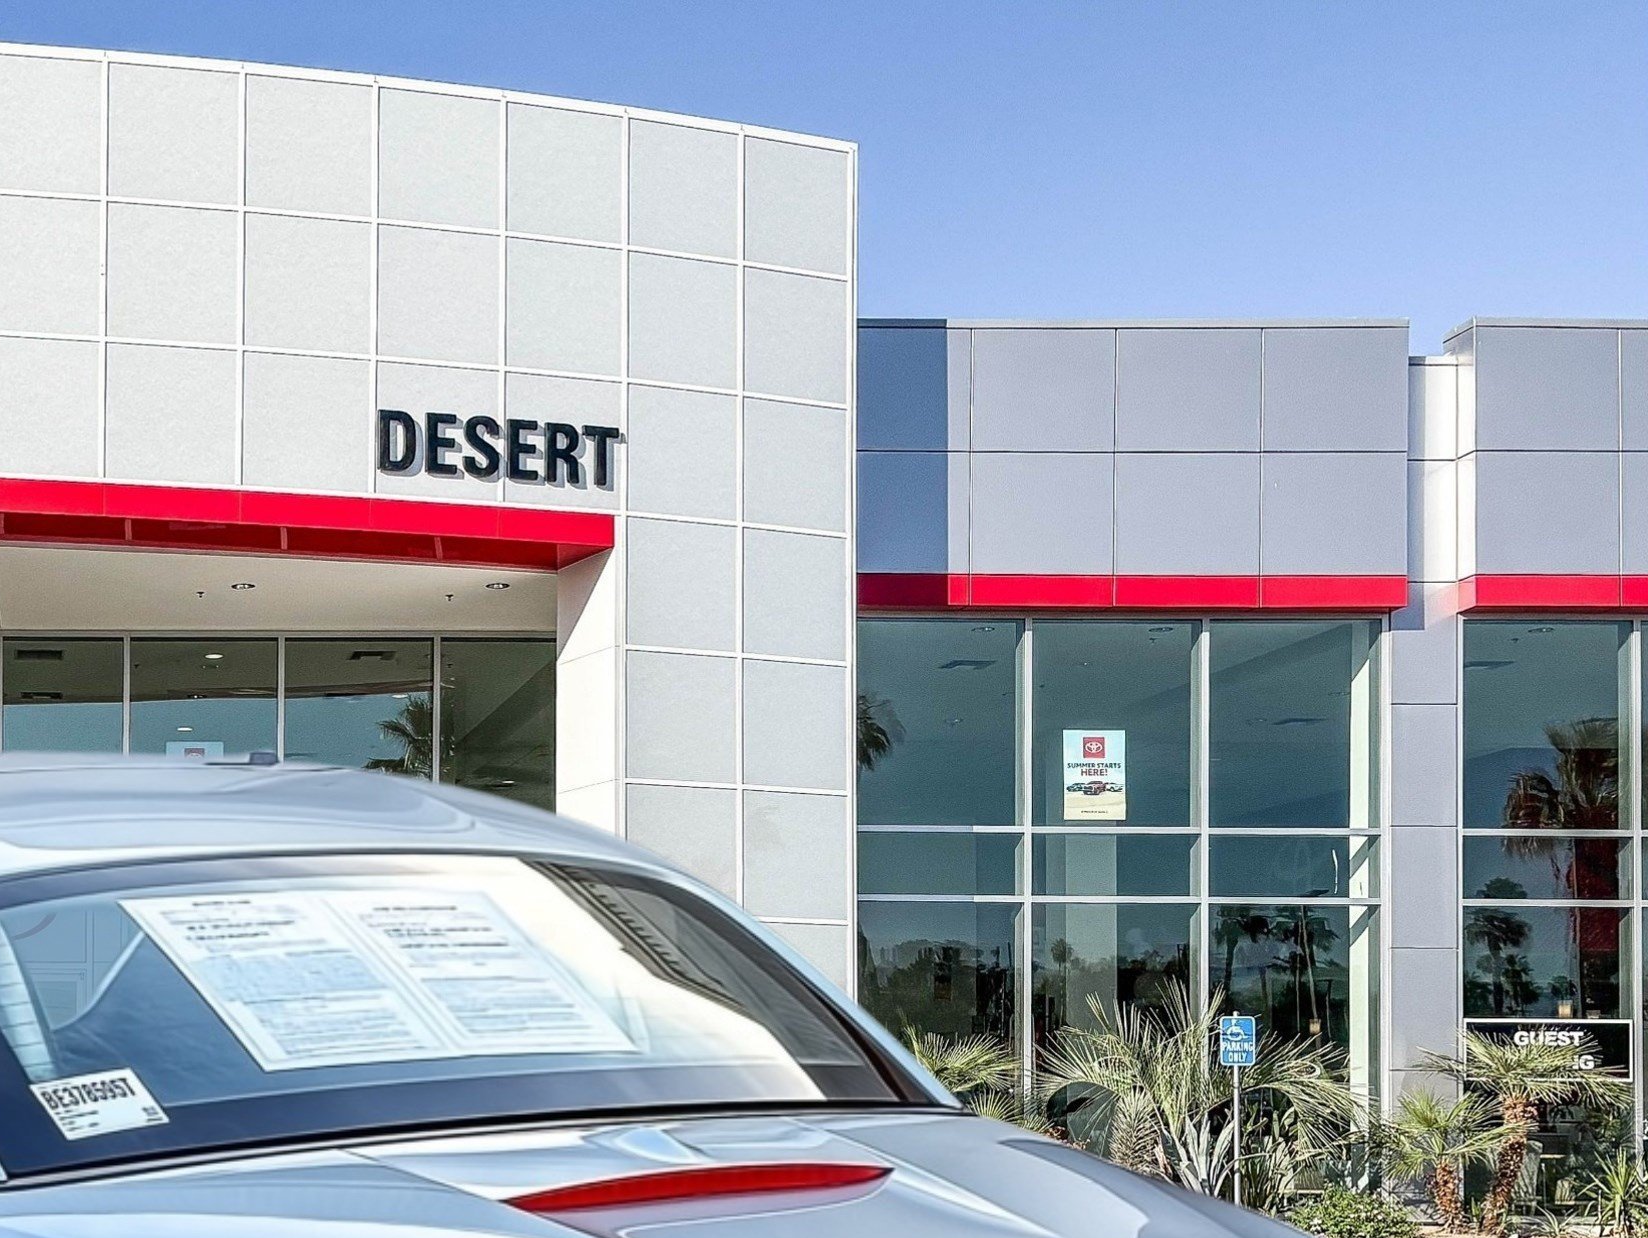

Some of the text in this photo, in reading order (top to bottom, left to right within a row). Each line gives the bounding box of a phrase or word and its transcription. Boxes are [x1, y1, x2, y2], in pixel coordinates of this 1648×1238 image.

[377, 409, 620, 487] DESERT
[1081, 768, 1108, 776] HERE!
[1513, 1030, 1585, 1047] GUEST
[1222, 1041, 1253, 1052] PARKING
[1228, 1052, 1247, 1062] ONLY
